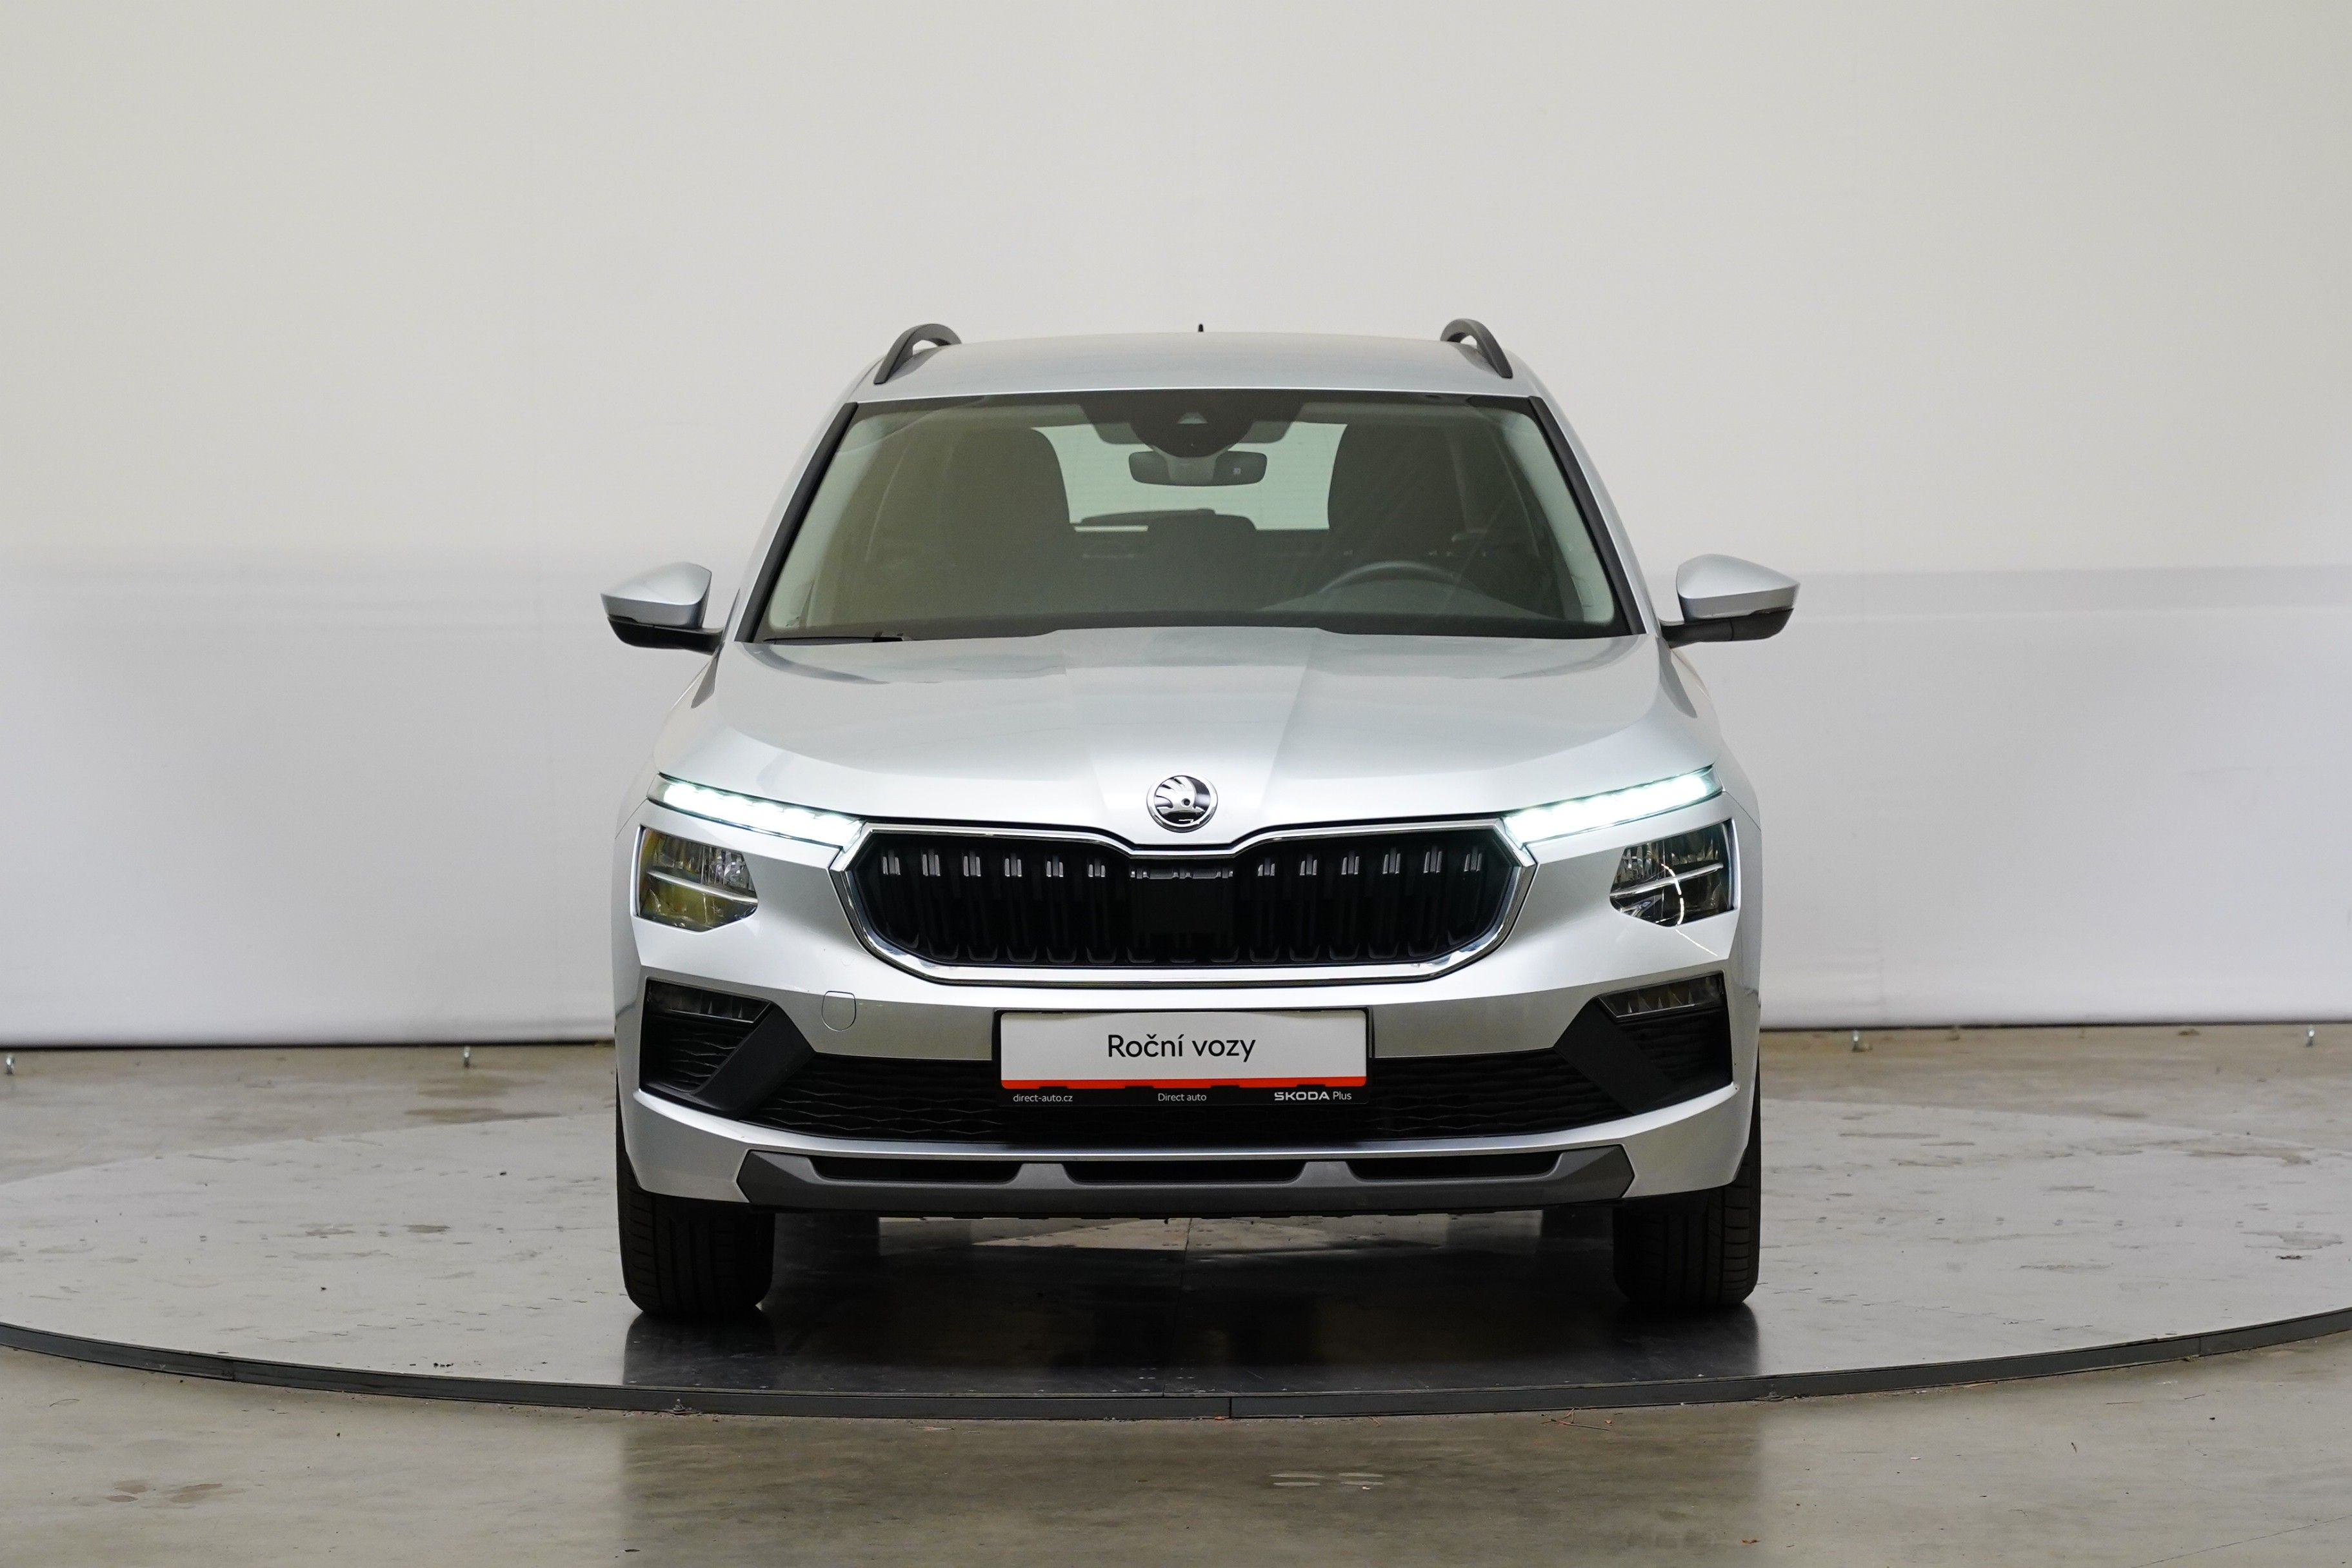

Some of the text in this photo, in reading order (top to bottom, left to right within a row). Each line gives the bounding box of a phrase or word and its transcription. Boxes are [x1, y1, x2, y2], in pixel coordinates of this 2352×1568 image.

[1108, 1033, 1256, 1063] Roční vozy
[1013, 1094, 1073, 1102] direct-auto.cz
[1158, 1093, 1207, 1102] Direct auto
[1333, 1091, 1352, 1100] Plus
